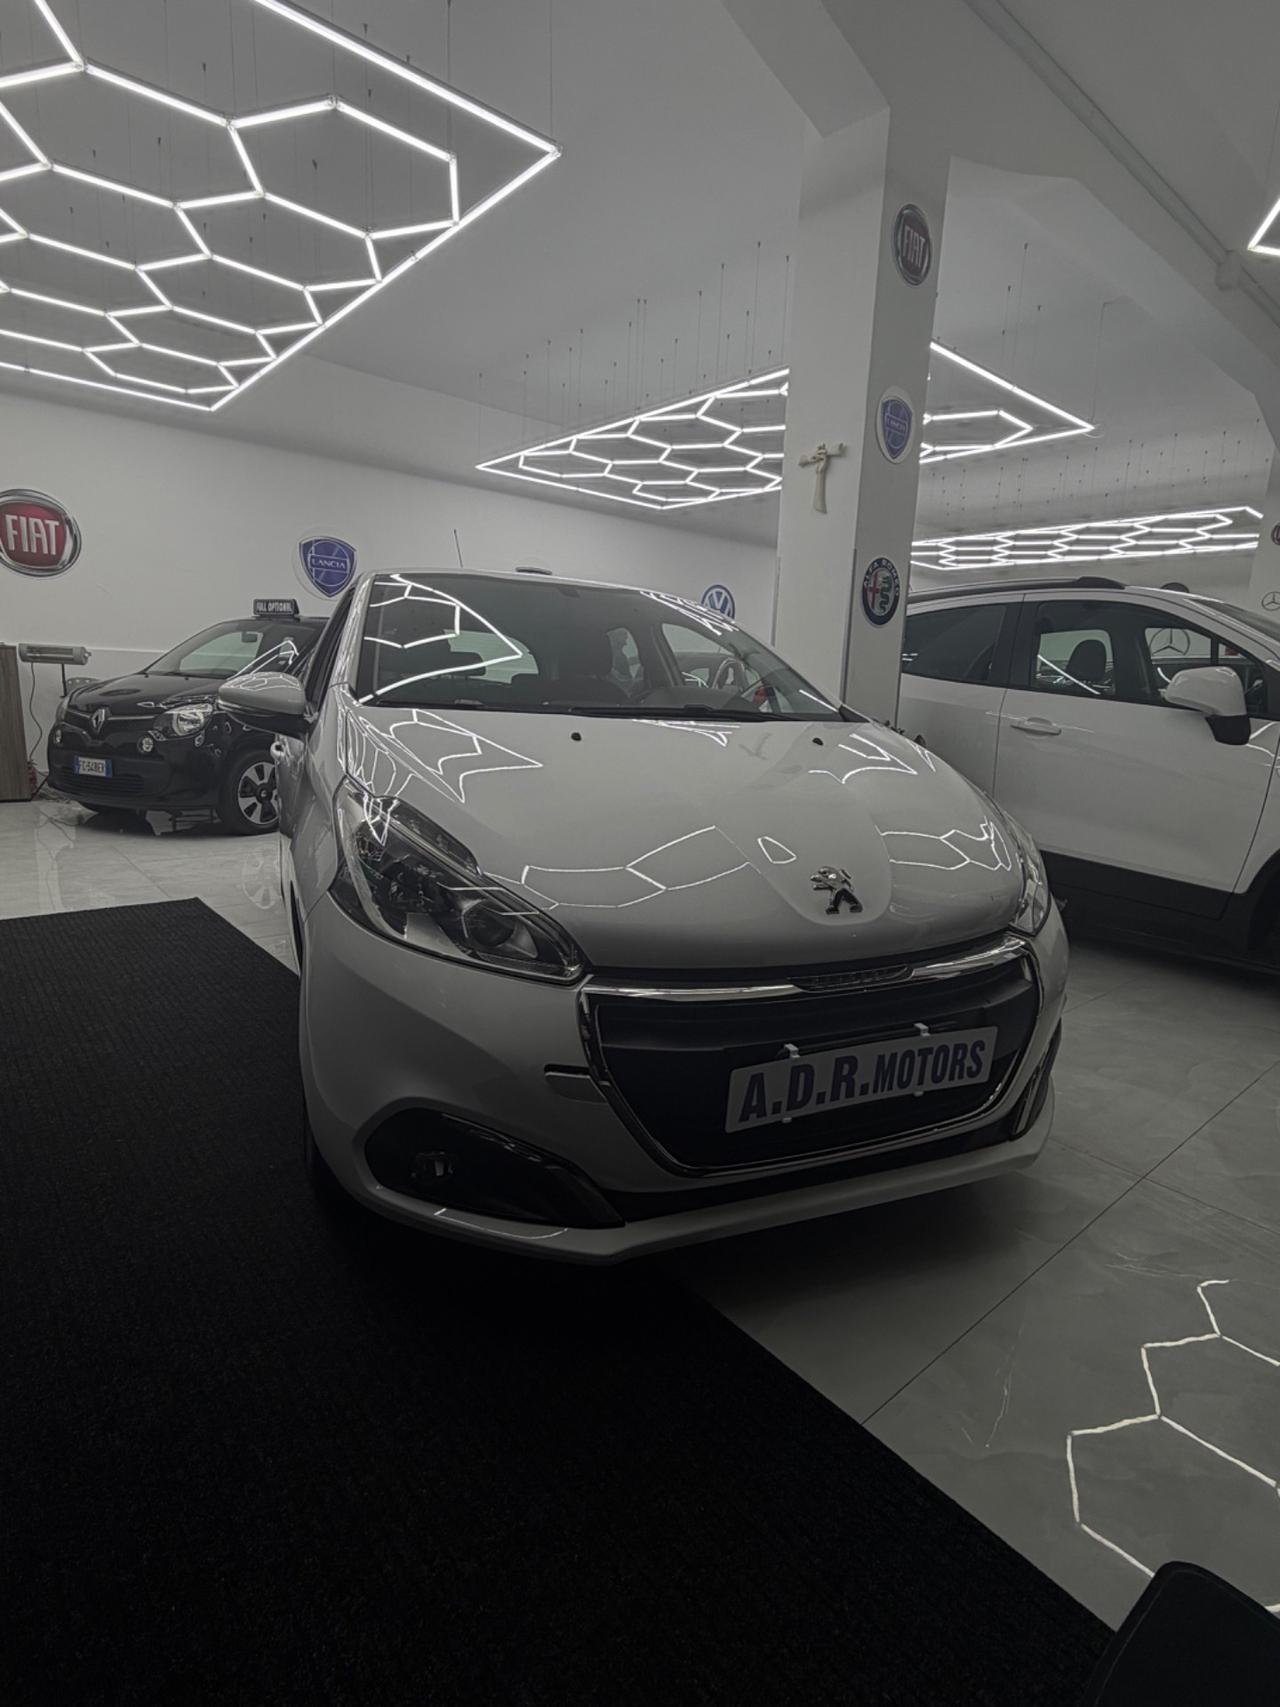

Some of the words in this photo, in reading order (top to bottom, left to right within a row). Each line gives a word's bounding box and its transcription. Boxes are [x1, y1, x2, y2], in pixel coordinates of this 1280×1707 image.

[903, 224, 926, 268] FIAT
[5, 514, 60, 556] FIAT
[312, 558, 346, 569] LANCIA
